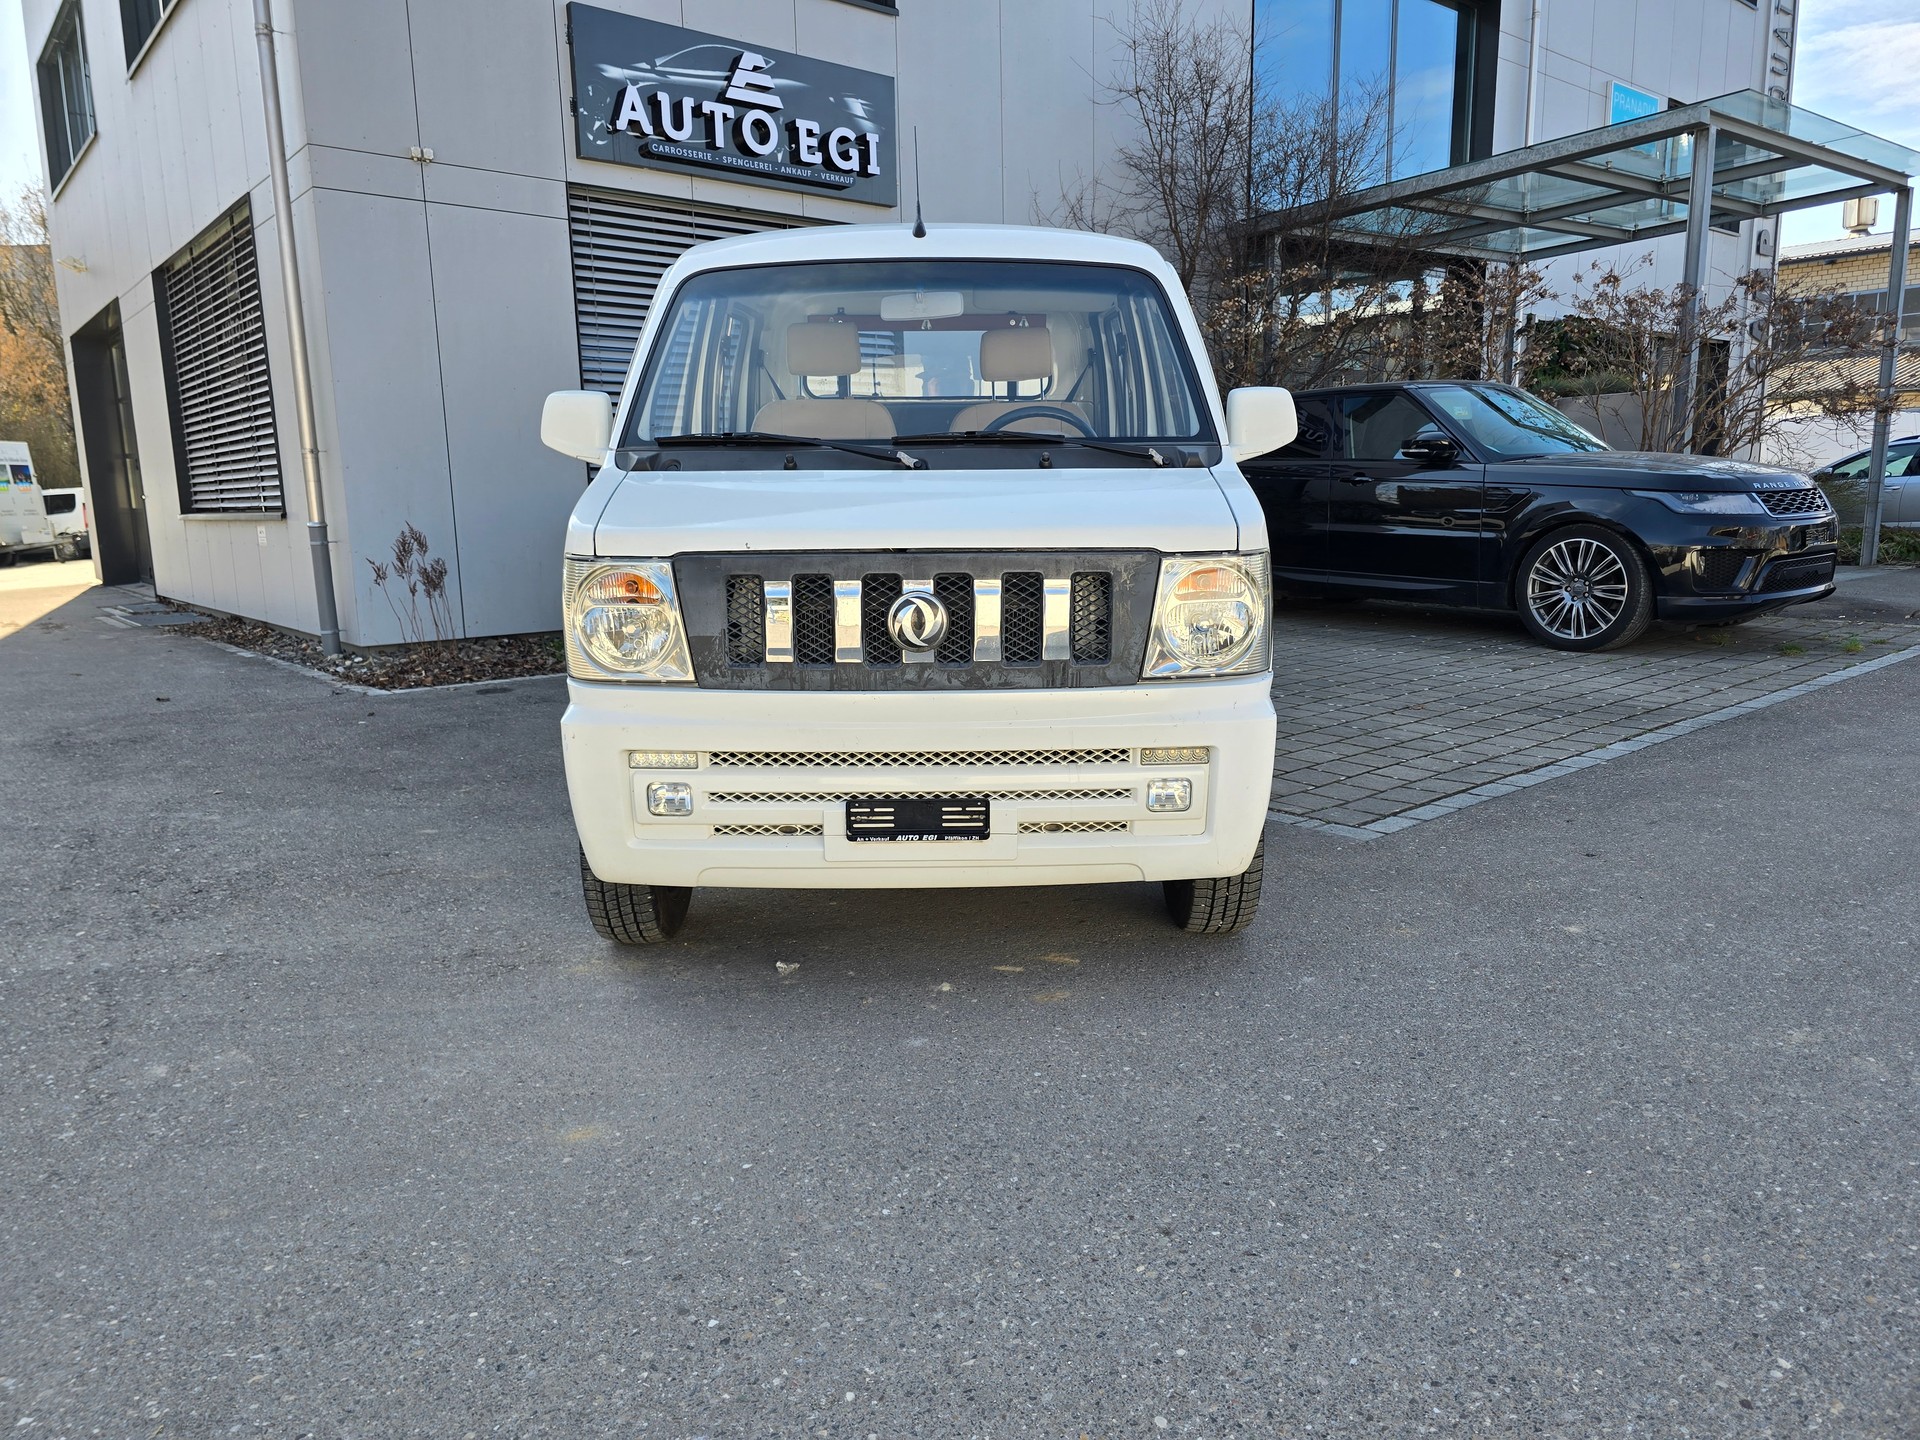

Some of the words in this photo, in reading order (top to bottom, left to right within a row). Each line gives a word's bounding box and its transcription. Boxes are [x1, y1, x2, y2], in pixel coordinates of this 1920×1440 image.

[613, 84, 779, 157] AUTO
[793, 118, 881, 176] EGI
[651, 143, 713, 161] CARROSSERIE
[722, 155, 772, 171] SPENGLEREI
[780, 166, 812, 177] ANKAUF
[820, 172, 854, 184] VERKAUF
[1752, 481, 1790, 489] RANGE
